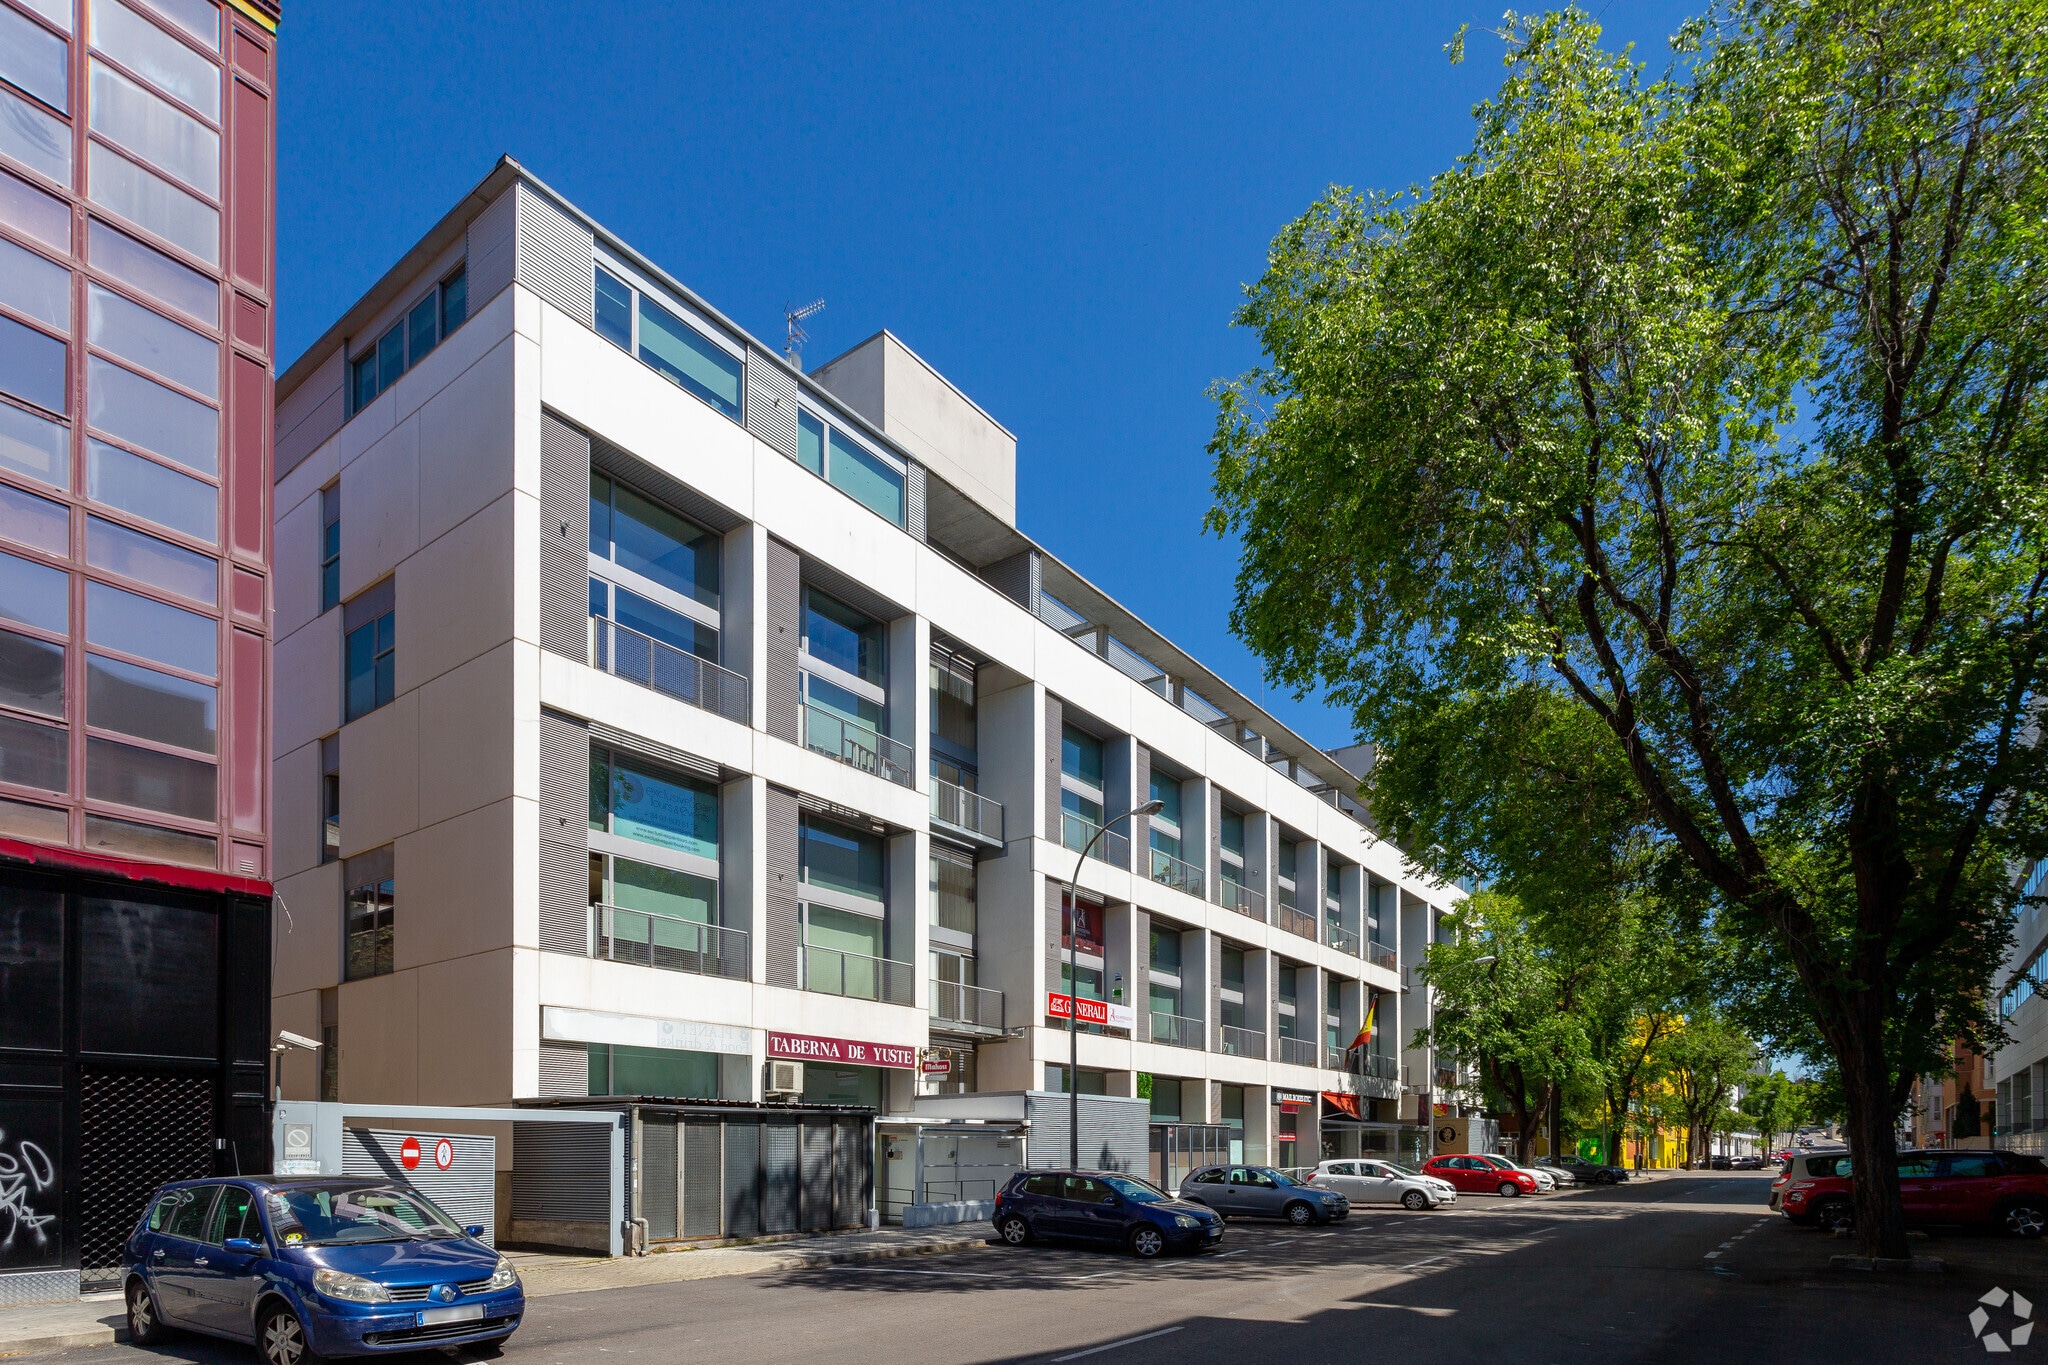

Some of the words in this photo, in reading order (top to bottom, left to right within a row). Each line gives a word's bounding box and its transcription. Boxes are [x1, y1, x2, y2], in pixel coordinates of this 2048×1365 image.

[1064, 1000, 1106, 1020] GNERALI
[770, 1036, 841, 1058] TABERNA
[848, 1044, 866, 1060] DE
[873, 1047, 913, 1064] YUSTE
[925, 1063, 947, 1071] Mahou
